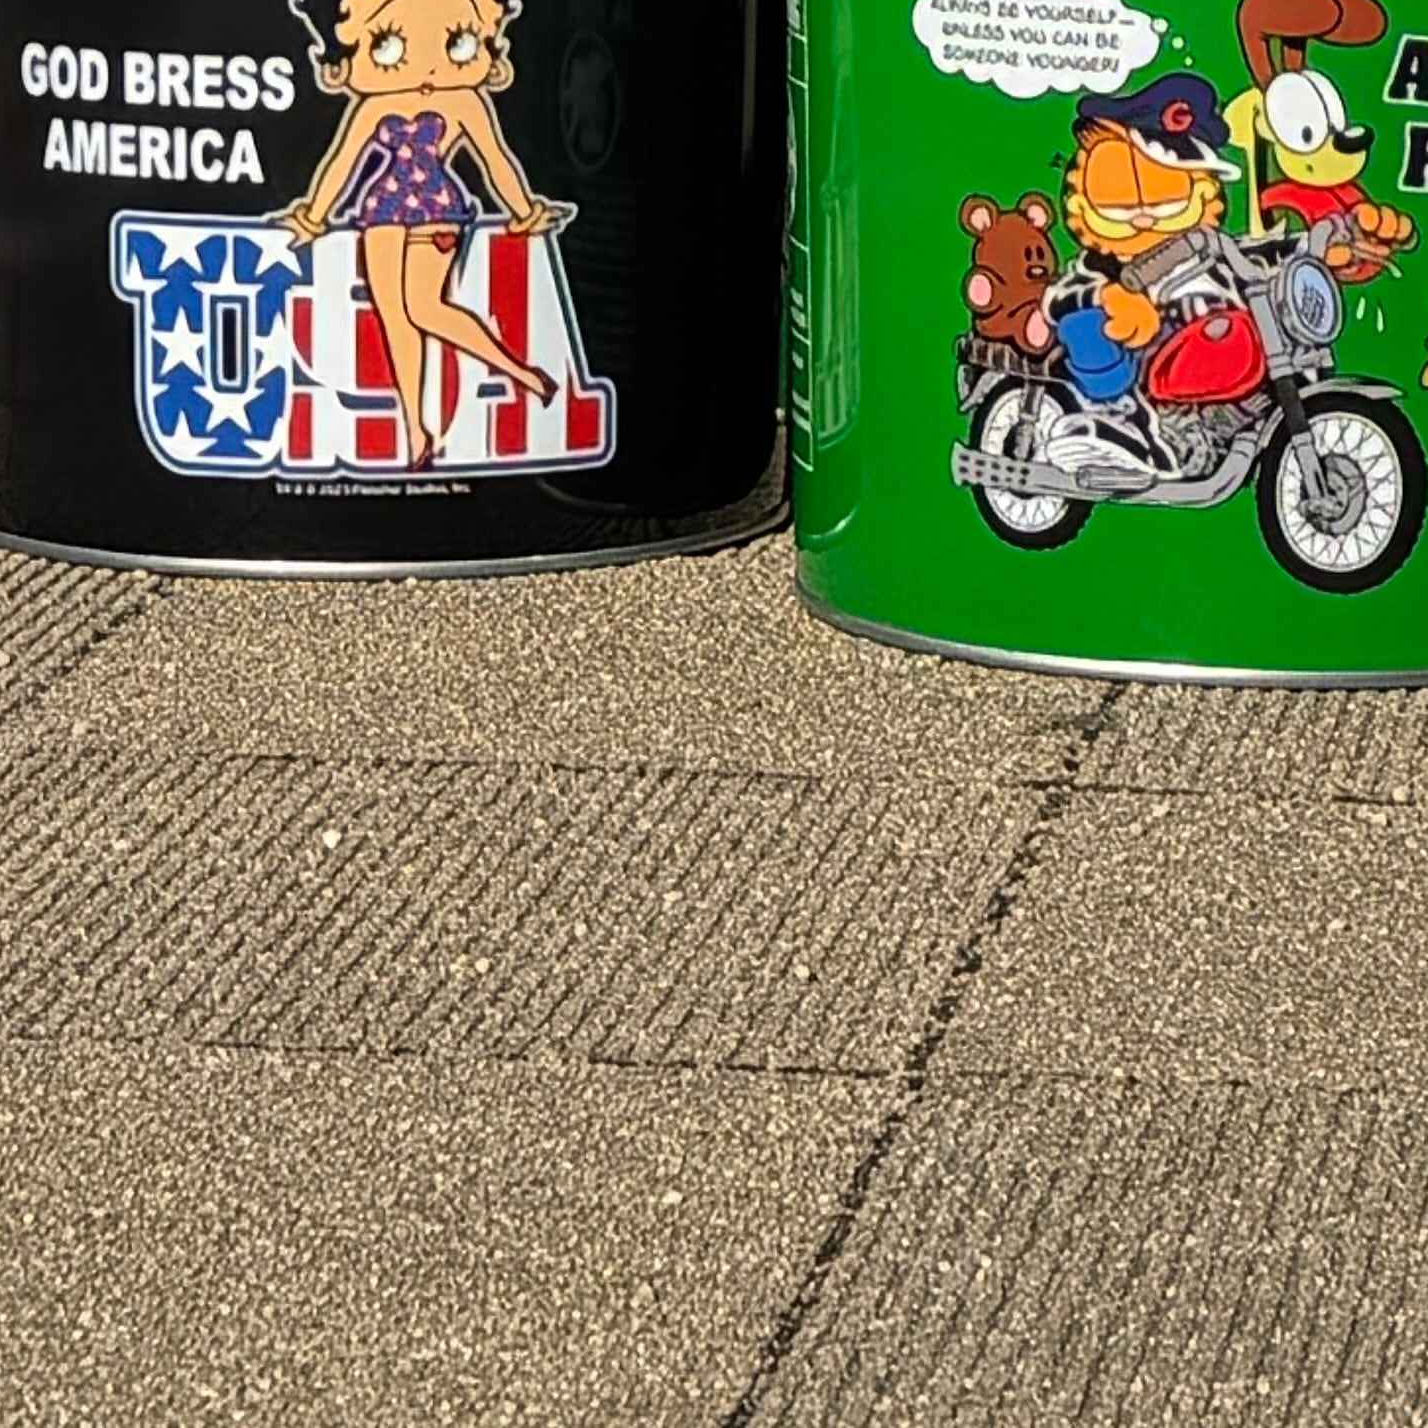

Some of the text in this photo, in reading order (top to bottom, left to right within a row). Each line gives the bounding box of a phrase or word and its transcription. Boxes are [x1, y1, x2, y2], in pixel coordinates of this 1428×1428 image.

[1010, 27, 1048, 45] YOU
[1051, 29, 1090, 49] CAN
[1094, 32, 1121, 50] BE
[21, 41, 296, 112] GOD BRESS
[1161, 100, 1194, 133] G
[43, 117, 265, 185] AMERICA
